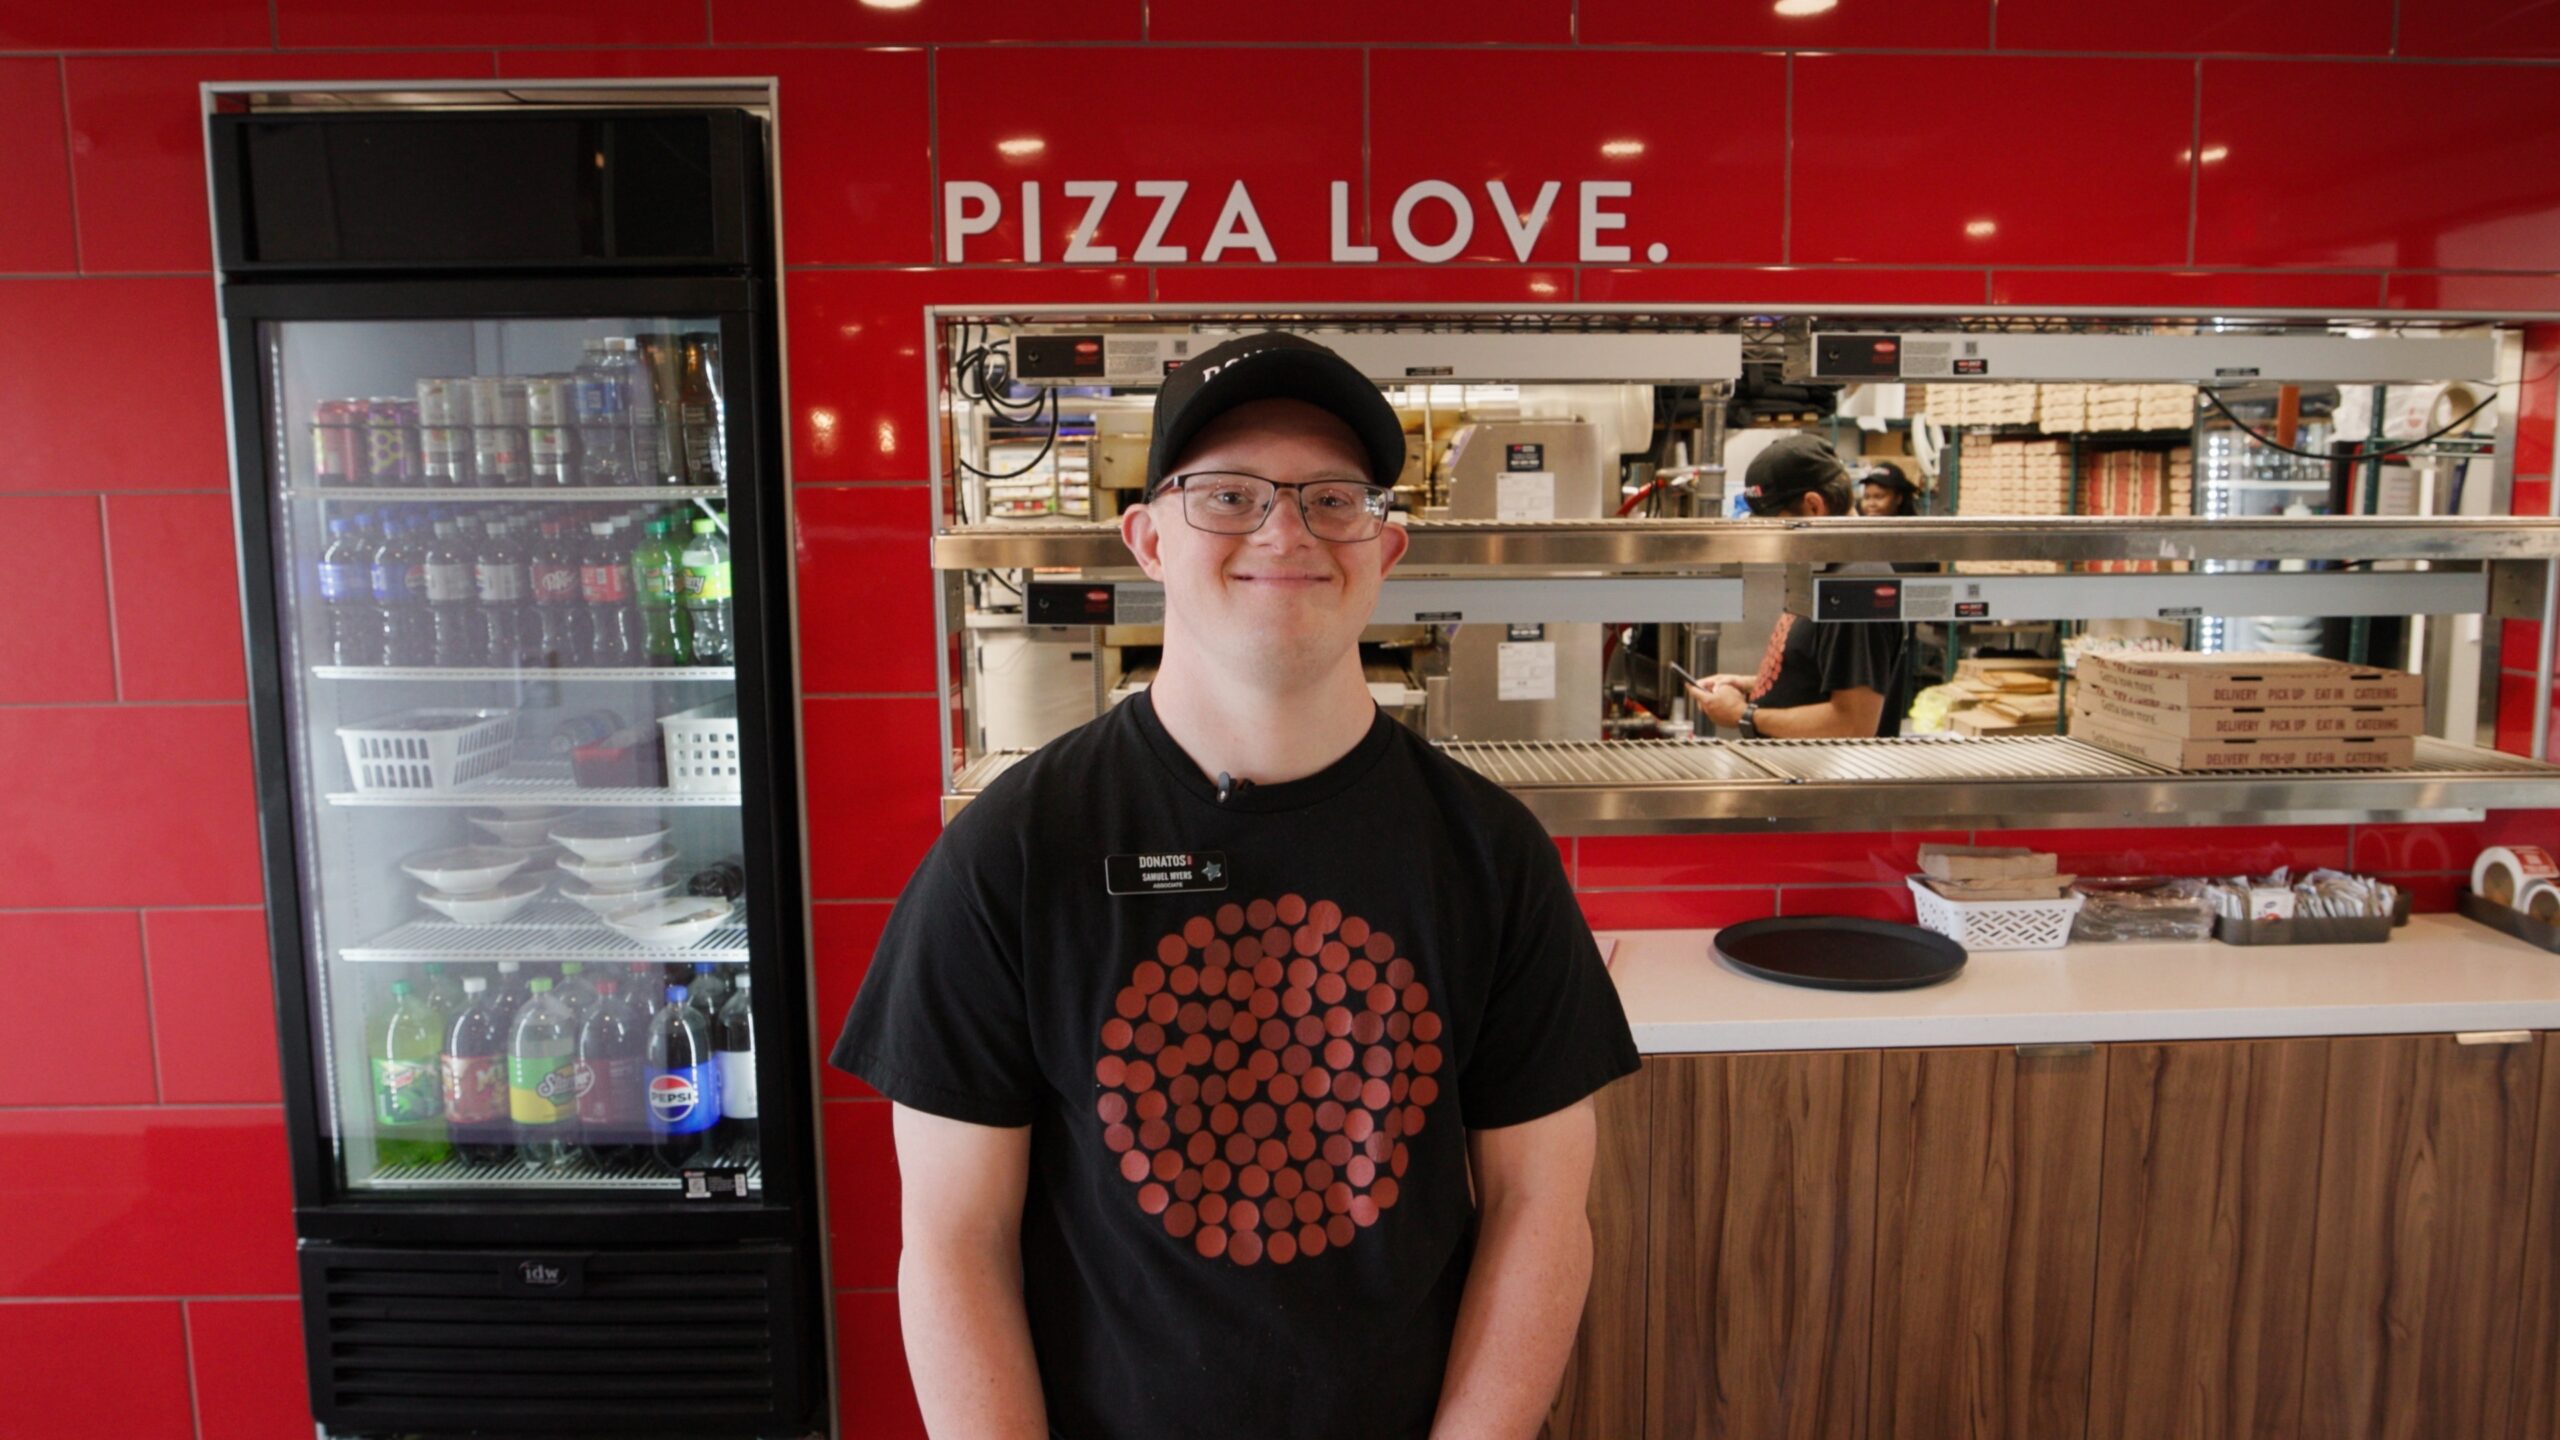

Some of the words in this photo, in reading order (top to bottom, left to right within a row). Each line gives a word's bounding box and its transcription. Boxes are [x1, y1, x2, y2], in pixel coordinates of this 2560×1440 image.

[944, 179, 1277, 263] PIZZA
[1331, 179, 1668, 263] LOVE.
[2214, 688, 2257, 701] DELIVERY
[2268, 688, 2289, 700] PICK
[2292, 688, 2305, 699] UP
[2314, 688, 2331, 700] EAT
[2333, 688, 2344, 699] IN
[2354, 687, 2398, 699] CATERING
[2216, 720, 2259, 732] DELIVERY
[2270, 719, 2290, 731] PICK
[2294, 719, 2306, 731] UP
[2316, 719, 2333, 731] EAT
[2335, 719, 2345, 730] IN
[2356, 718, 2398, 731] CATERING
[2206, 753, 2249, 766] DELIVERY
[2345, 752, 2388, 764] CATERING
[1139, 855, 1186, 868] DONATOS
[1142, 872, 1169, 882] SAMUEL
[1170, 871, 1192, 881] MYERS
[651, 1092, 692, 1103] PEPSI
